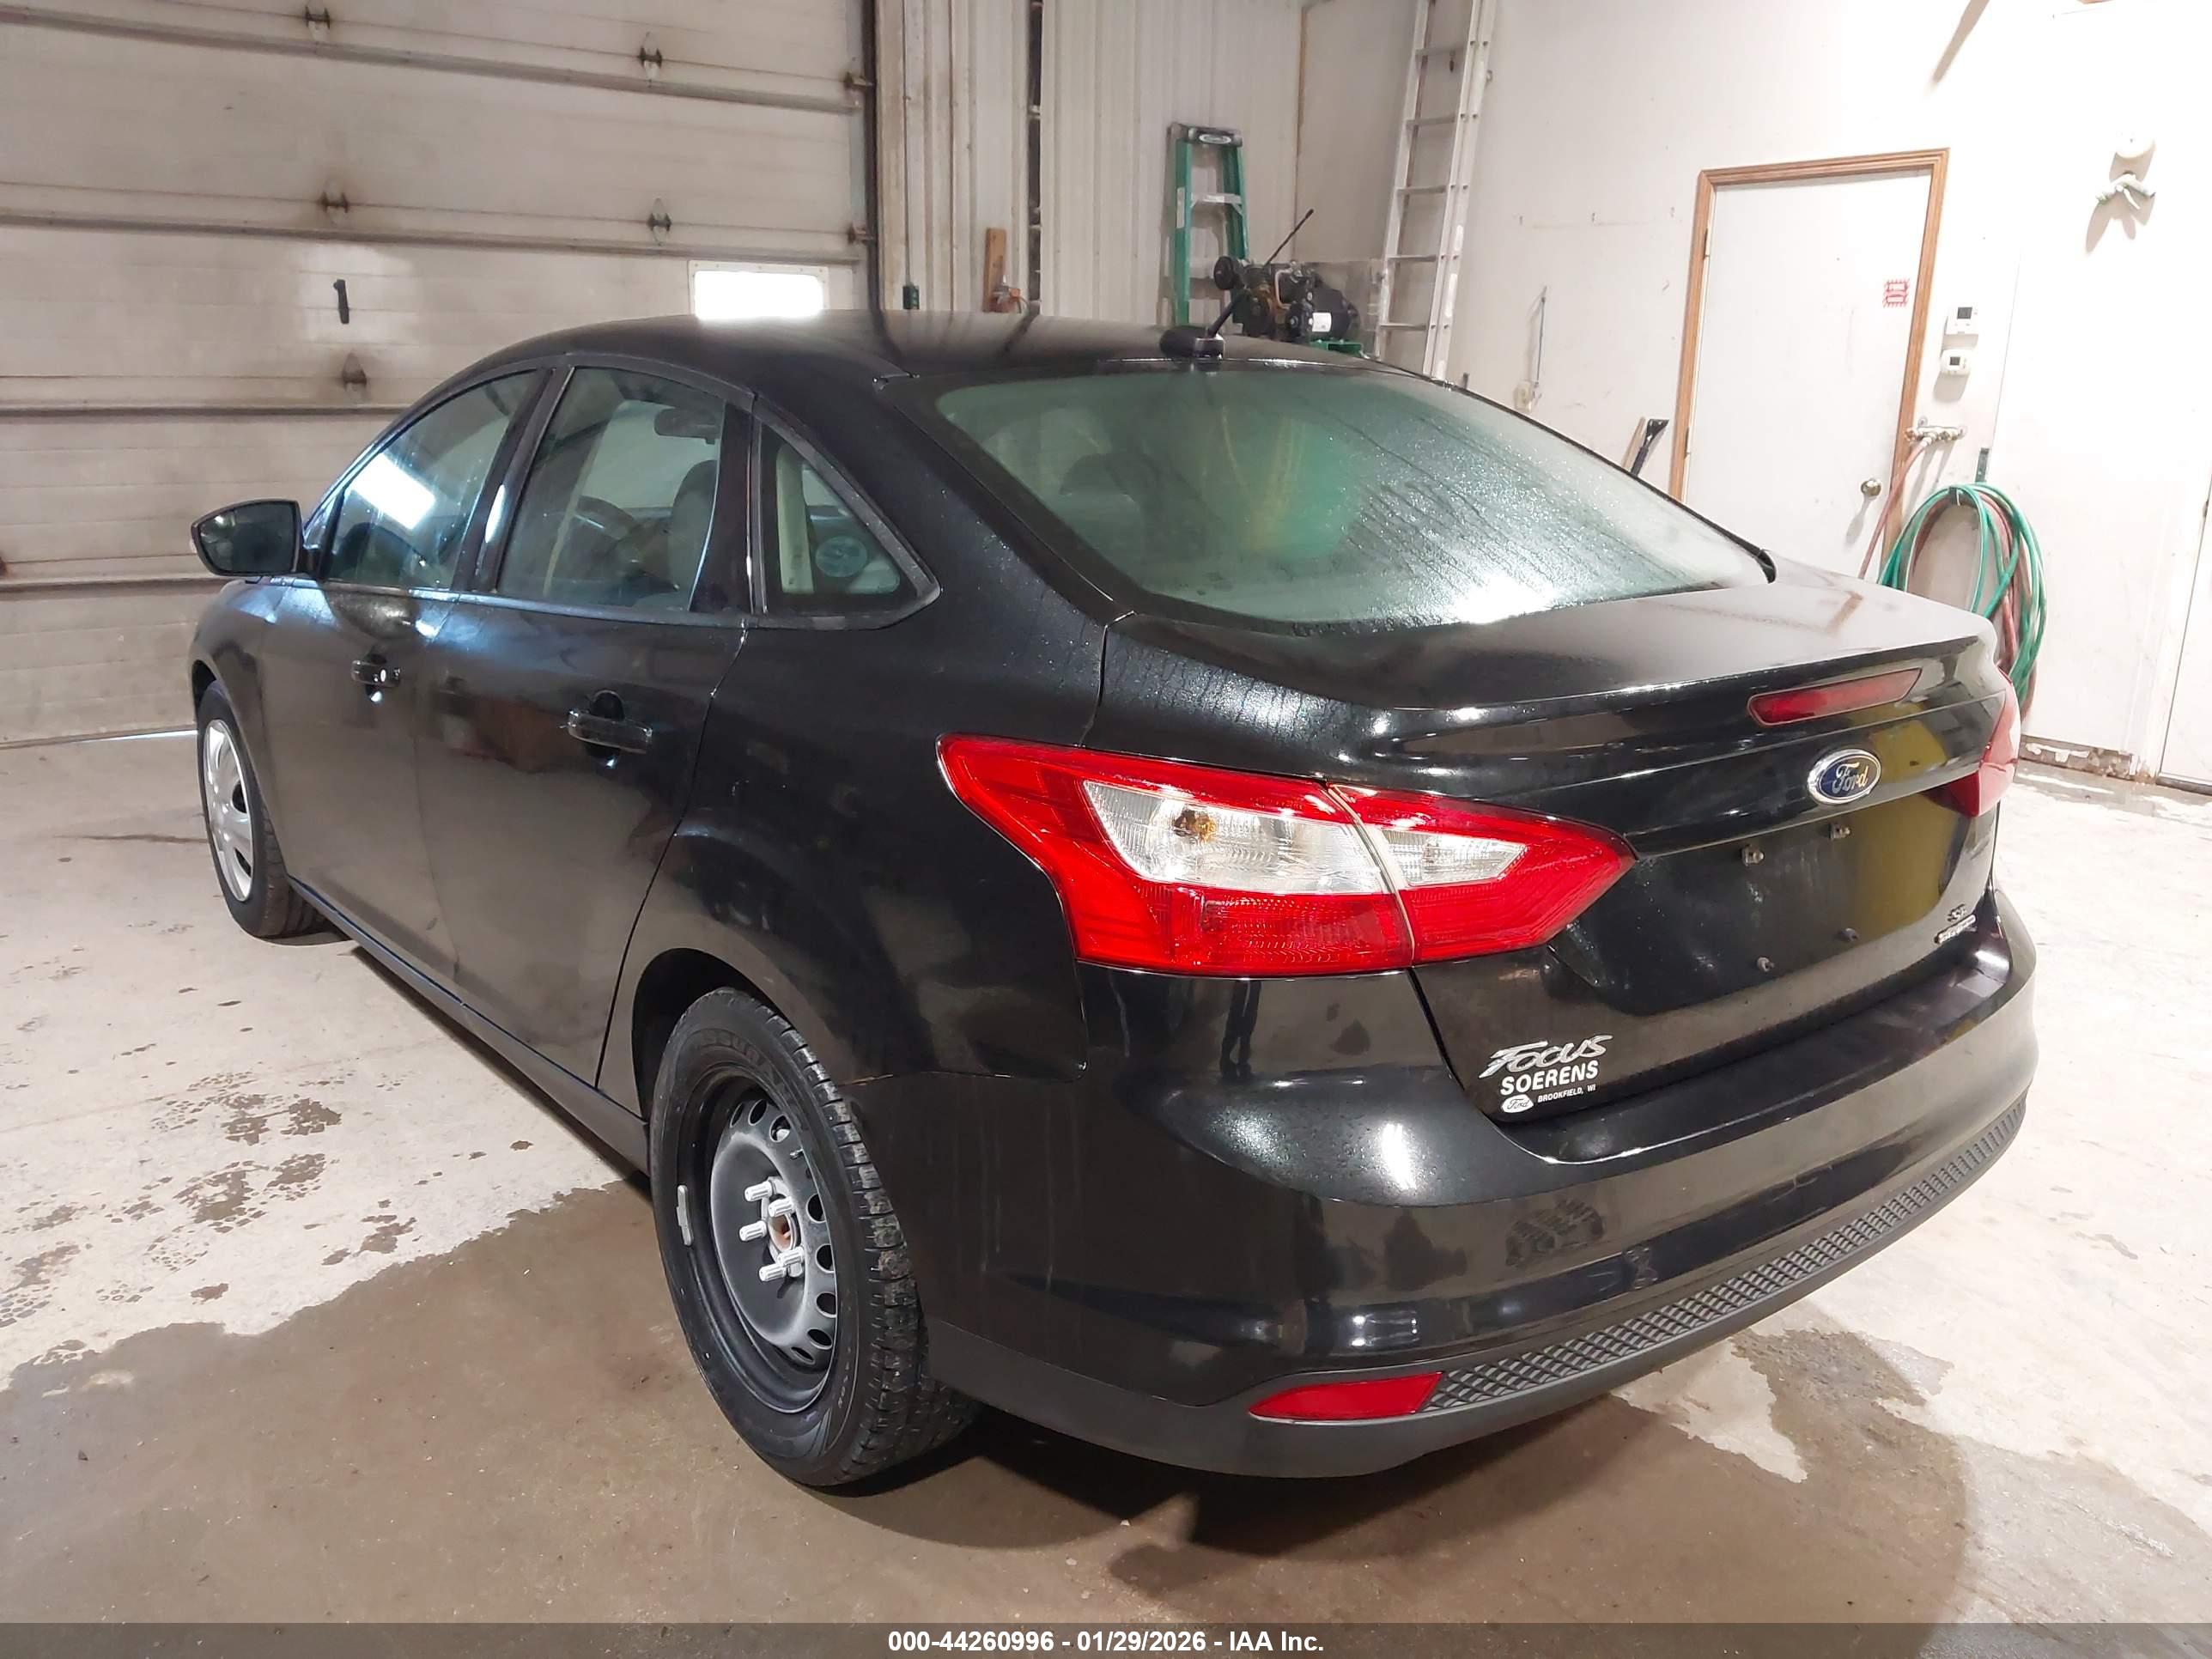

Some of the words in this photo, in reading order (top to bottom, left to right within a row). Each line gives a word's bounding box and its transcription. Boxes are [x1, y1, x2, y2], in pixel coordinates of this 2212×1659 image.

[1832, 762, 1869, 794] Ford
[1500, 1060, 1599, 1096] SOERENS
[1537, 1086, 1584, 1103] BROOKFIELD,
[1587, 1084, 1596, 1093] WI
